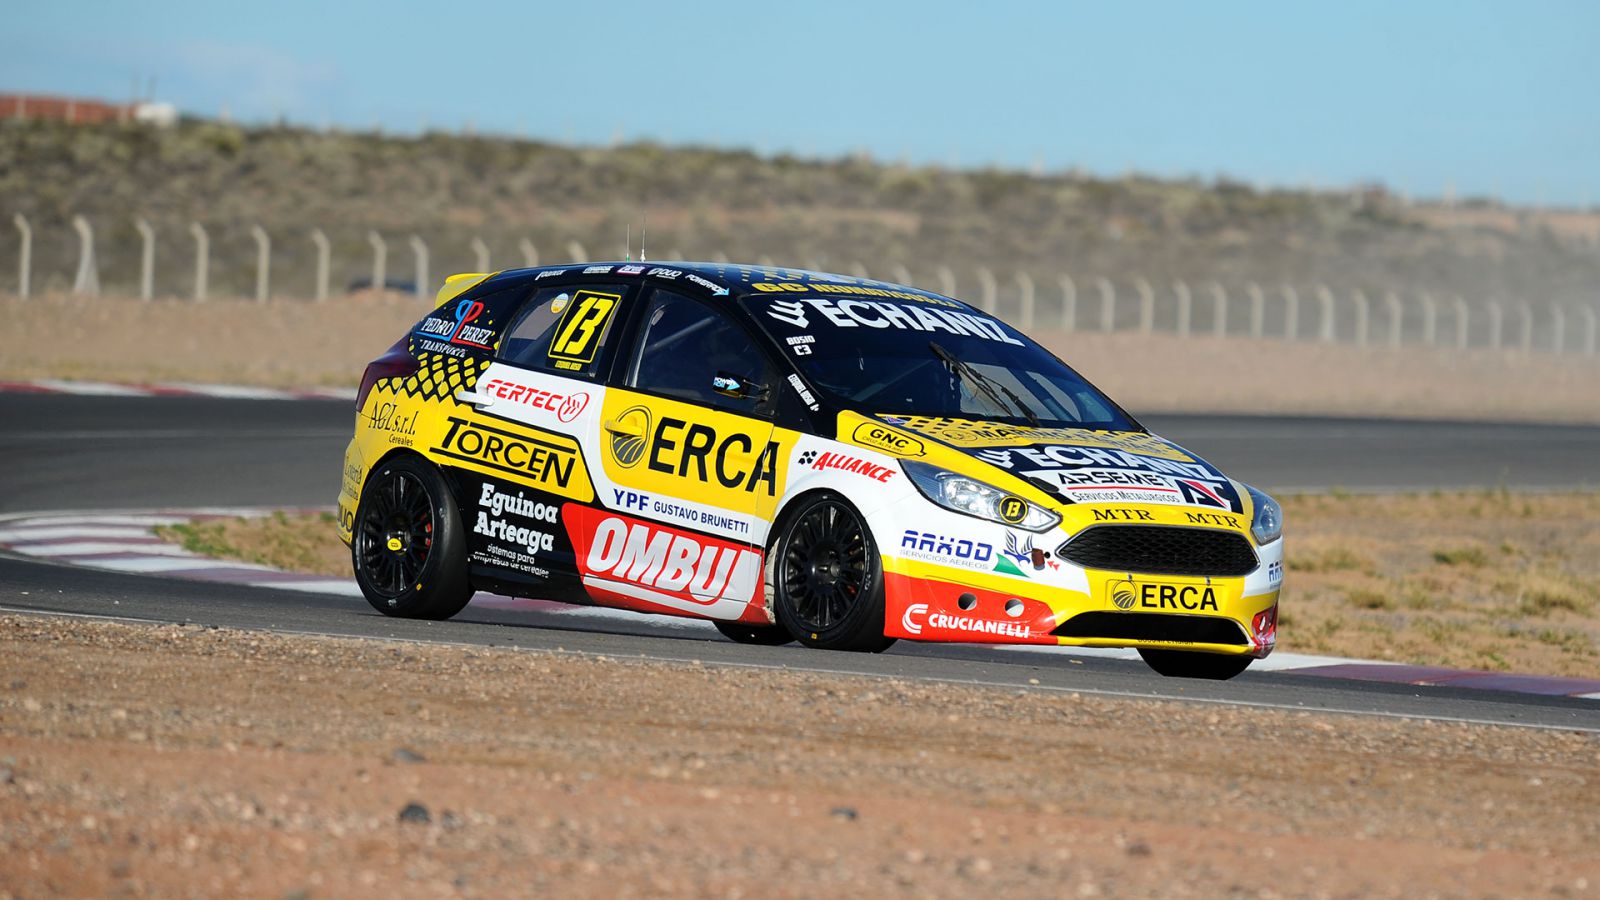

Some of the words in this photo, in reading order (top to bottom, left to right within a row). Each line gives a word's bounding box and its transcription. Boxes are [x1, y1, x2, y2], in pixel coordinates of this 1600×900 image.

[752, 282, 808, 293] GC
[421, 317, 455, 336] PEDRO
[458, 325, 492, 345] PEREZ
[553, 297, 614, 355] 13
[786, 335, 816, 345] BOSIO
[793, 345, 812, 356] C3
[486, 379, 564, 412] FERTEC
[388, 433, 414, 447] Cereales
[870, 428, 909, 449] GNC
[441, 416, 576, 488] TORCEN
[648, 416, 780, 497] ERCA
[811, 451, 897, 483] ALLIANCE
[1059, 472, 1174, 488] ARSEMET
[478, 482, 558, 523] Eguinoa
[613, 488, 650, 511] YPF
[654, 501, 698, 521] GUSTAVO
[700, 512, 749, 534] BRUNETTI
[1006, 501, 1021, 517] 13
[1091, 509, 1156, 521] MTR
[473, 511, 554, 555] Arteaga
[1184, 512, 1242, 529] MTR
[517, 552, 535, 565] para
[586, 517, 738, 602] OMBU
[900, 549, 948, 563] SERVICIOS
[1141, 584, 1219, 611] ERCA
[928, 613, 1031, 638] CRUCIANELLI
